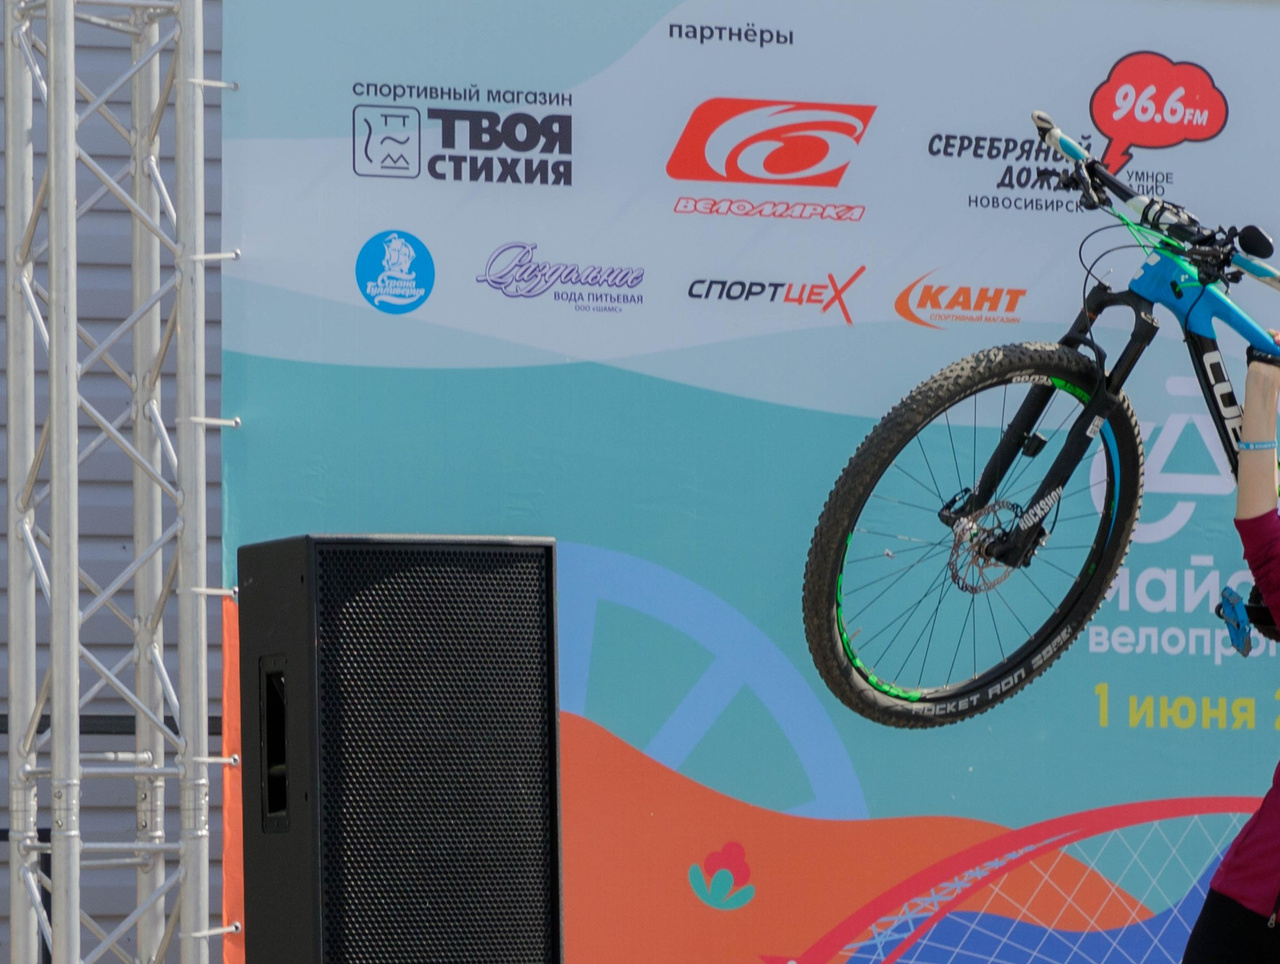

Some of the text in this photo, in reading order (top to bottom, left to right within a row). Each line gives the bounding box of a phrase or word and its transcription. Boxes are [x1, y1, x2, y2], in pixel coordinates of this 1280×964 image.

[669, 23, 794, 48] партнёры
[352, 82, 573, 107] спортивный магазин
[427, 108, 573, 155] ТВОЯ
[427, 154, 573, 187] СТИХИЯ
[673, 197, 866, 221] ВЕЛОМАРКА
[968, 195, 1085, 214] НОВОСИБИРСК
[554, 291, 644, 305] ВОДА ПИТЬЕВАЯ
[916, 284, 1028, 314] КАНТ
[1094, 682, 1109, 728] 1
[1129, 695, 1256, 729] июня
